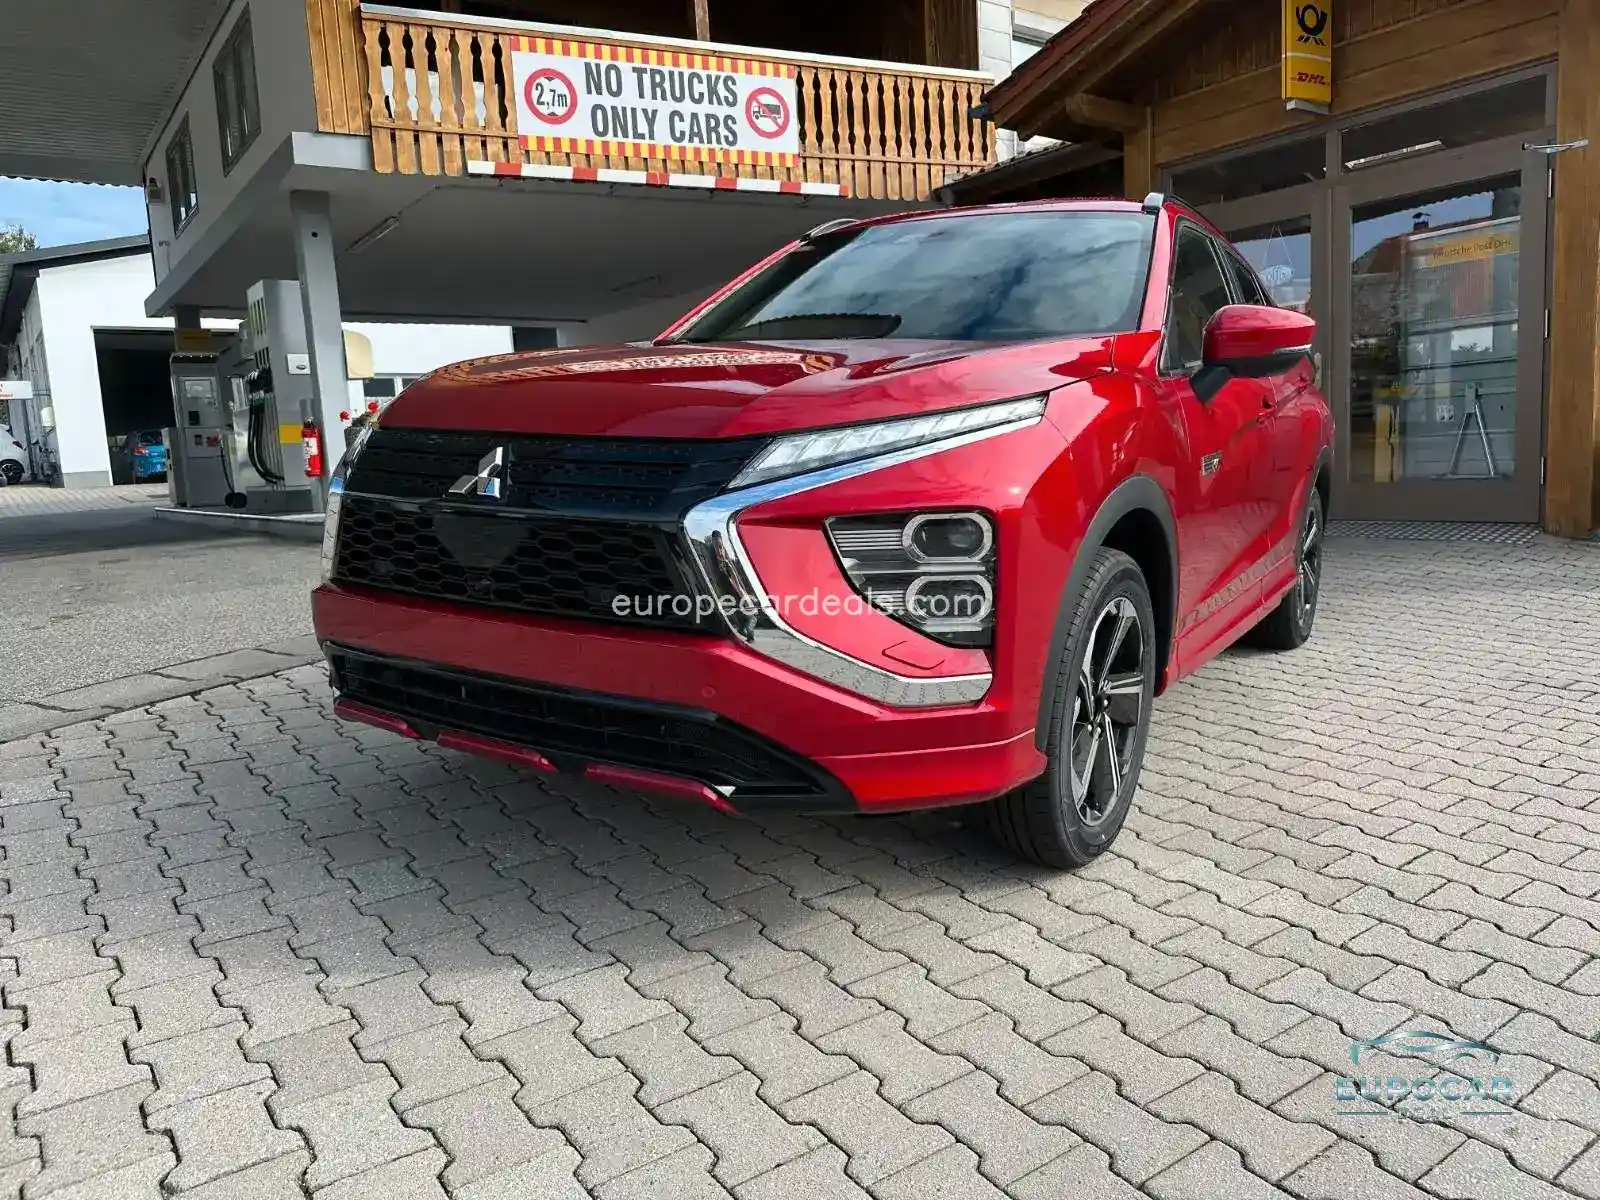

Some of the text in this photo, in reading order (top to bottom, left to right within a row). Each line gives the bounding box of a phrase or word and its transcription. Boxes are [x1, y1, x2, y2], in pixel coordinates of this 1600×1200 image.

[535, 82, 568, 110] 2,7m
[584, 61, 738, 108] NO TRUCKS
[1296, 71, 1326, 86] DHL
[591, 104, 738, 147] ONLY CARS
